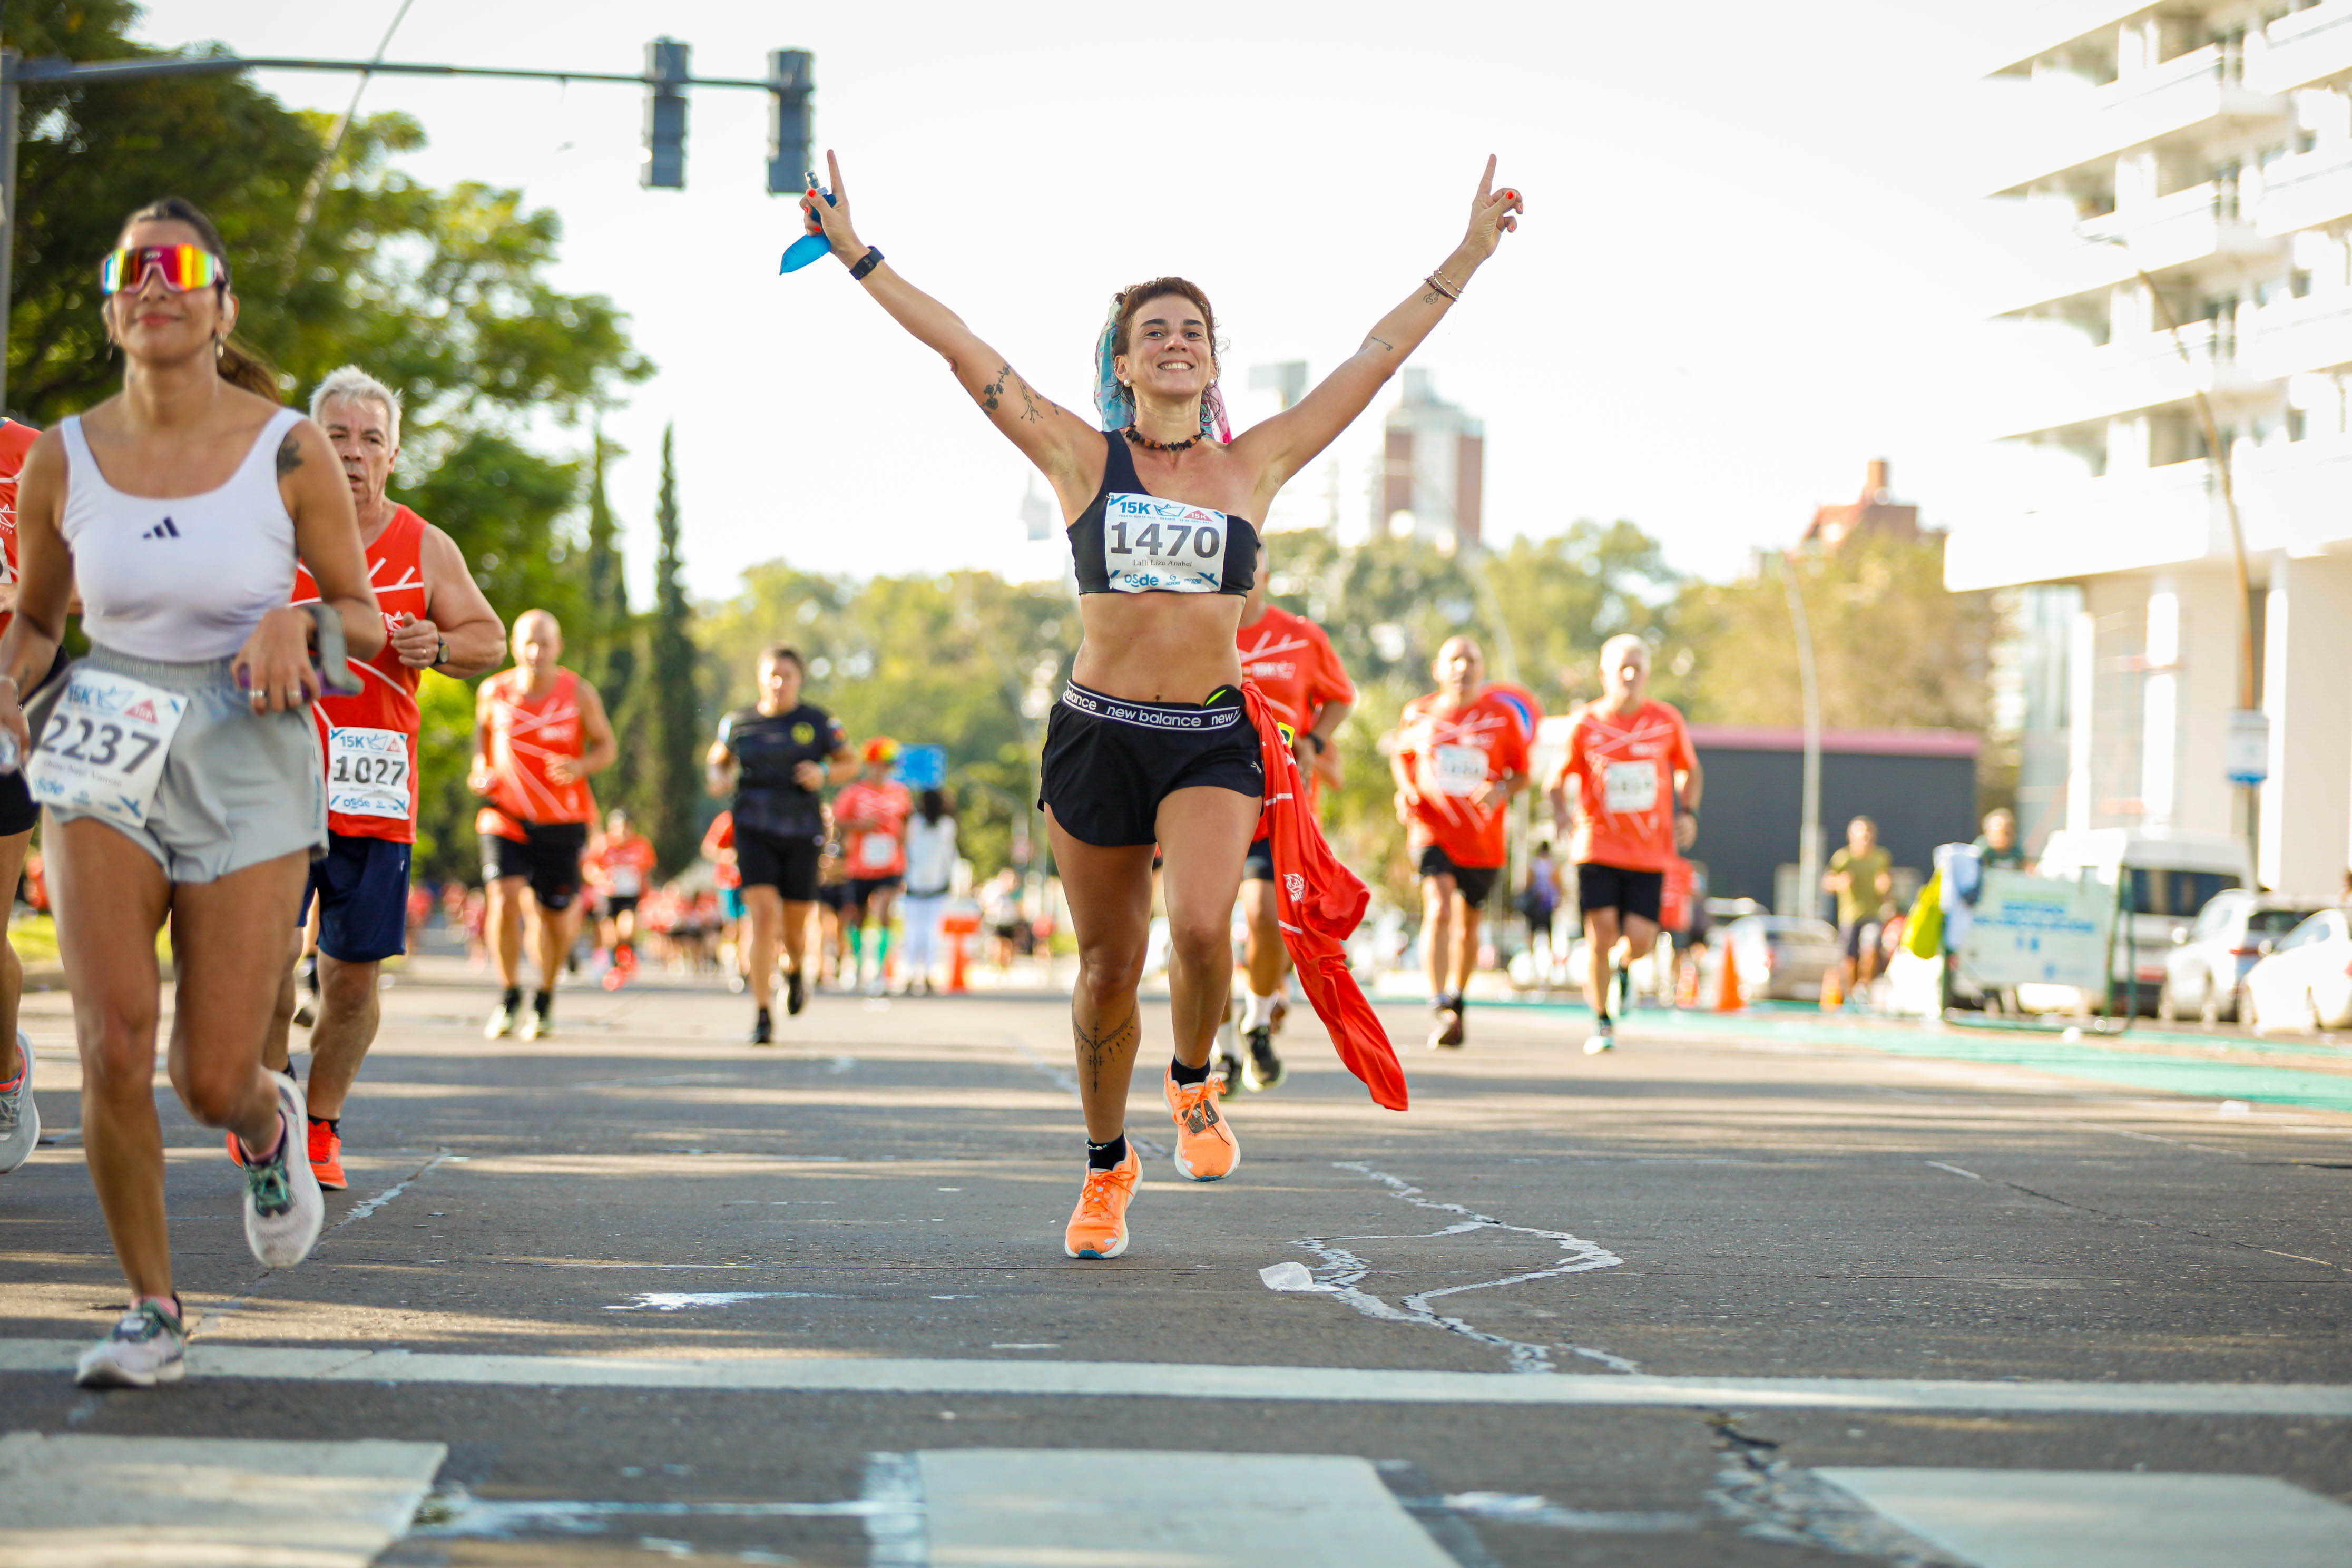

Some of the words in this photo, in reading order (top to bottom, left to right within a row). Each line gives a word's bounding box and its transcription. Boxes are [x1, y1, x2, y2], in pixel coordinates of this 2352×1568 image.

[1120, 502, 1151, 515] 15K
[1111, 521, 1220, 558] 1470
[1124, 573, 1159, 587] osde
[1106, 704, 1138, 721] new
[1139, 709, 1201, 727] balance
[1212, 712, 1233, 725] new
[40, 713, 161, 773] 2237
[340, 735, 364, 748] 15K
[334, 754, 406, 786] 1027
